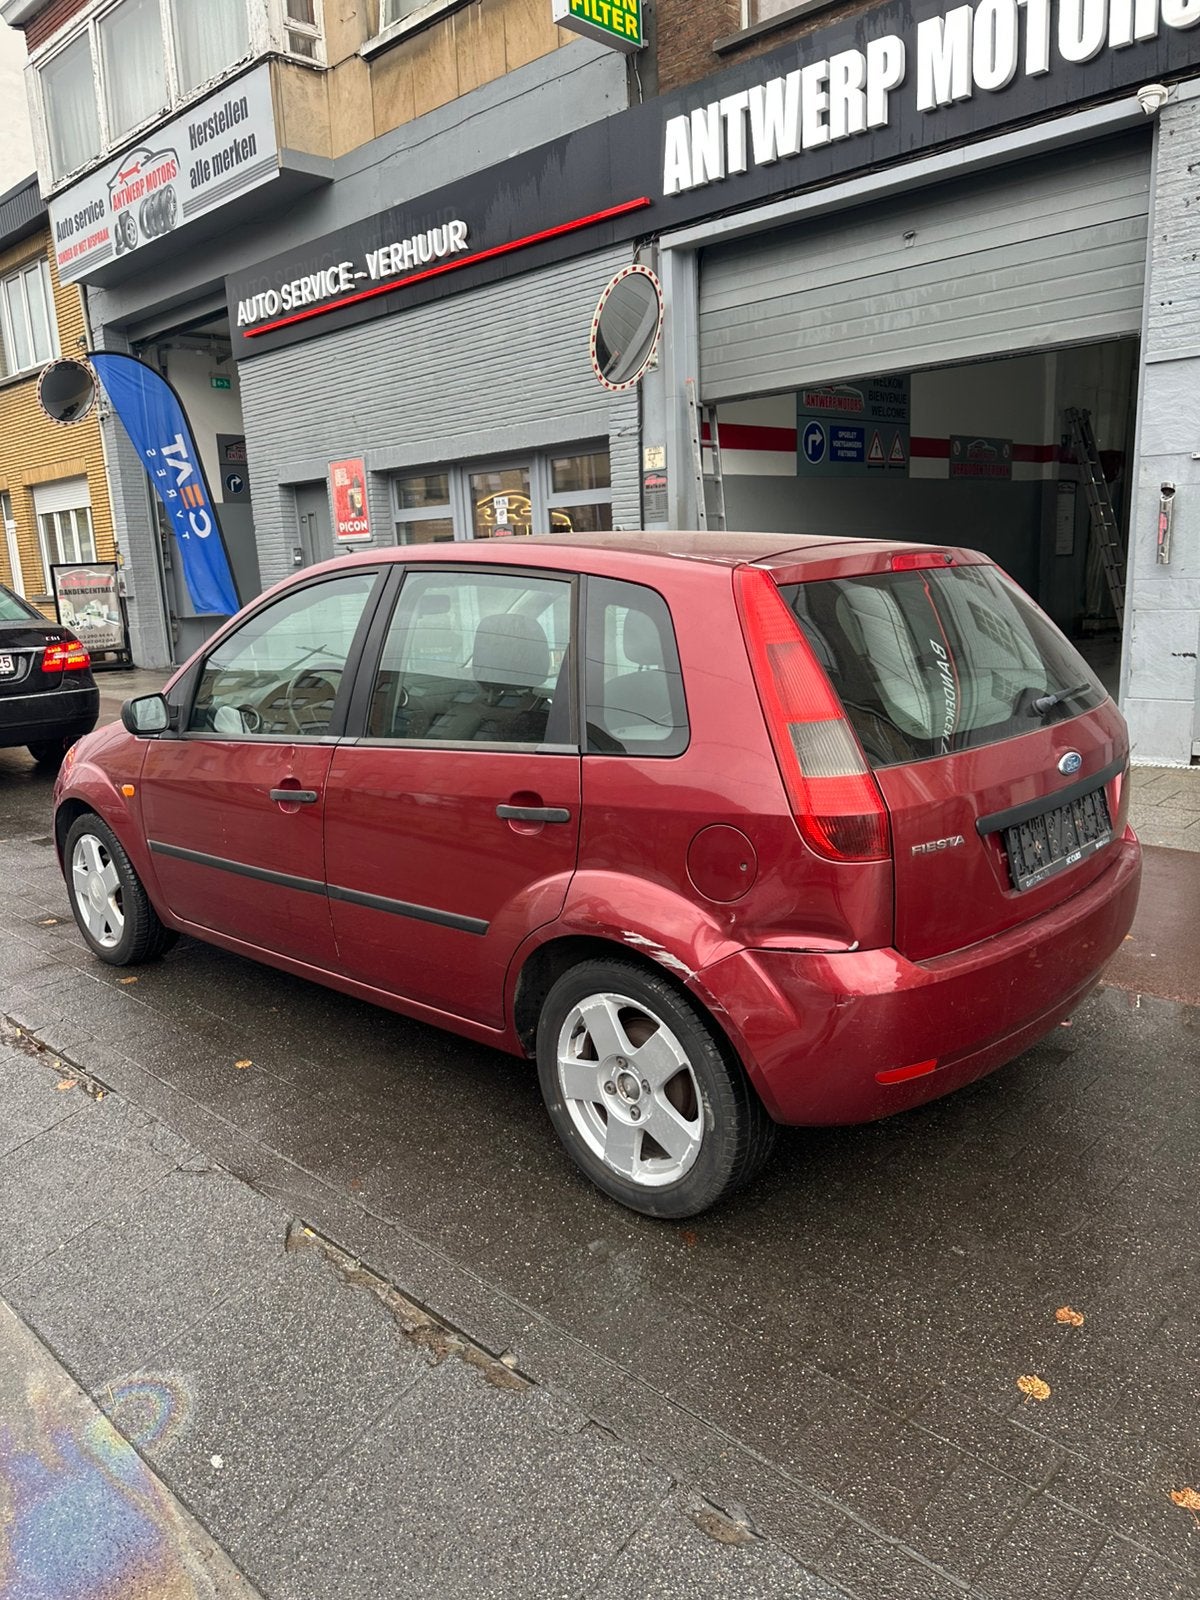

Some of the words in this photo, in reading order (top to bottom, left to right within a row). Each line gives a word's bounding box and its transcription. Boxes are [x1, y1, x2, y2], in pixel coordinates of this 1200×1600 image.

[188, 96, 249, 150] Herstellen
[662, 33, 906, 197] ANTWERP
[112, 180, 146, 212] ANTWERP
[146, 159, 178, 192] MOTORS
[189, 159, 212, 190] alle
[212, 132, 257, 174] merken
[56, 217, 75, 243] Auto
[74, 198, 105, 232] service
[237, 289, 282, 327] AUTO
[281, 261, 355, 311] SERVICE
[366, 219, 469, 280] VERHUUR
[868, 390, 907, 405] BIENVENUE
[872, 405, 907, 419] WELCOME
[339, 519, 368, 533] PICON
[911, 834, 965, 857] FIESTA
